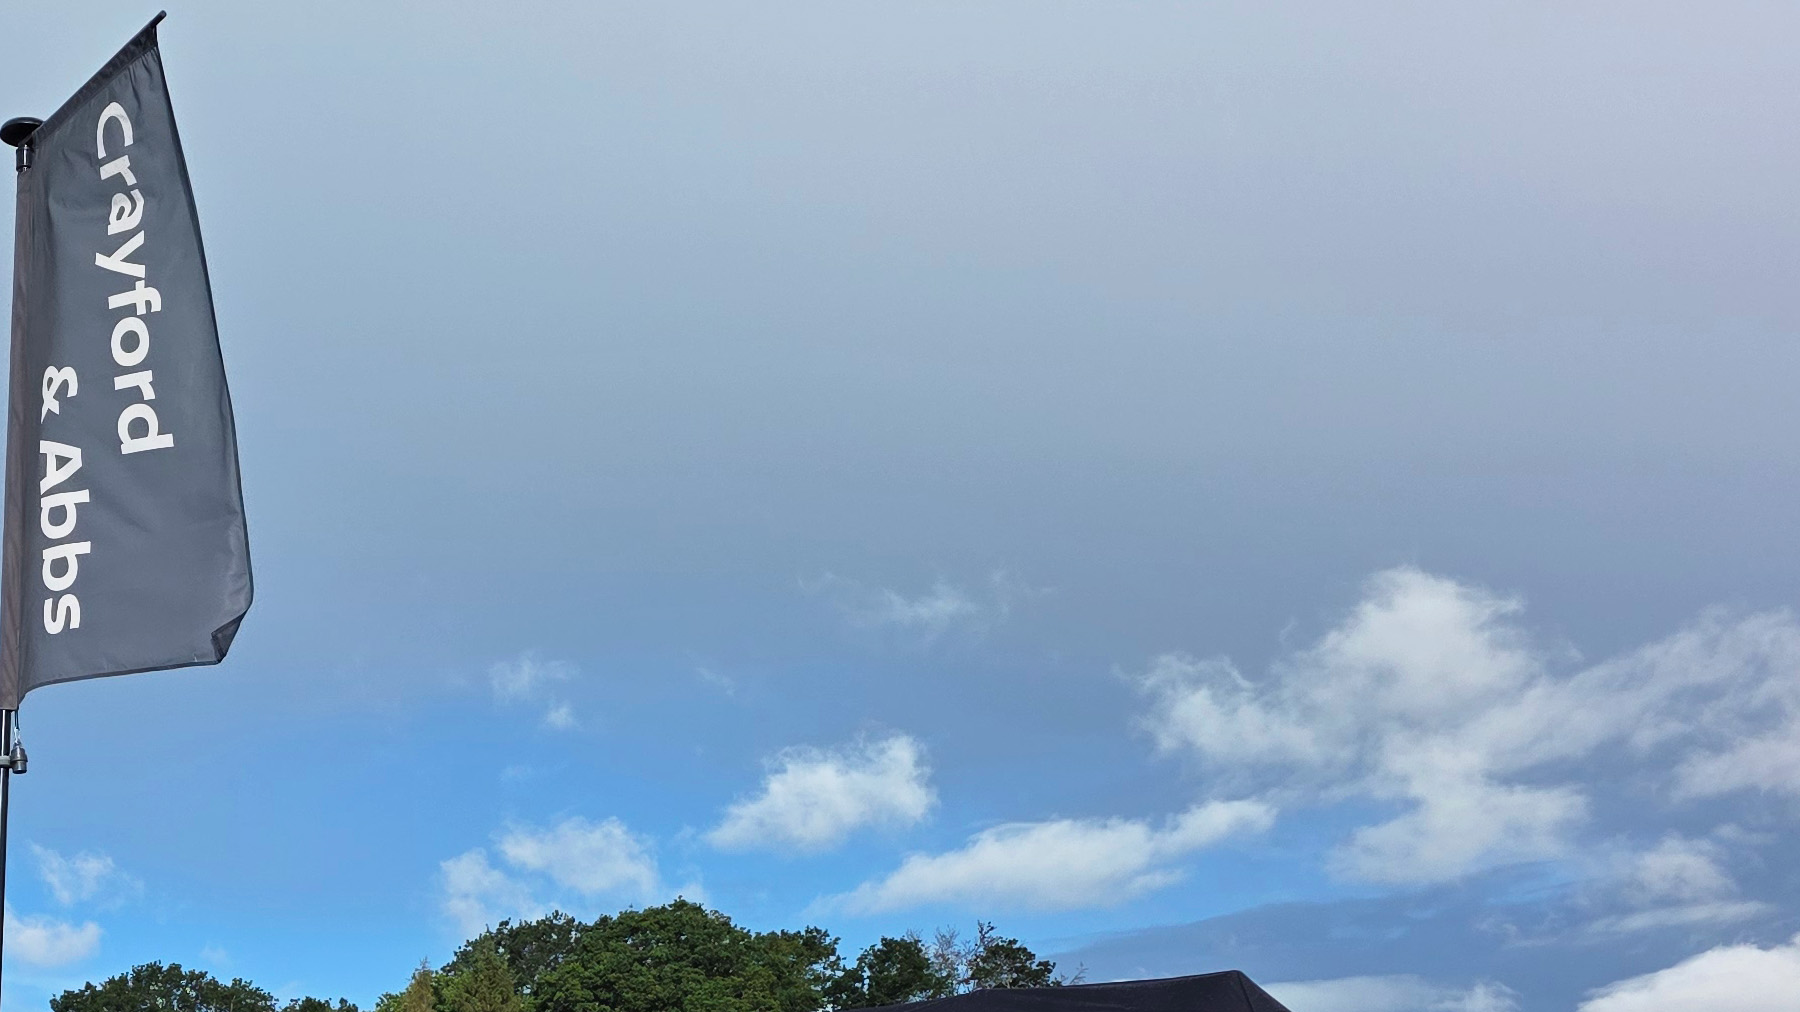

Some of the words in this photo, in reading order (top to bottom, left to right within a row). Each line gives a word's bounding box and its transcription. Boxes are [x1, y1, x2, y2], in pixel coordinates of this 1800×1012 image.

[94, 100, 175, 456] Crayford
[40, 365, 78, 423] &
[39, 439, 92, 635] Abbs
